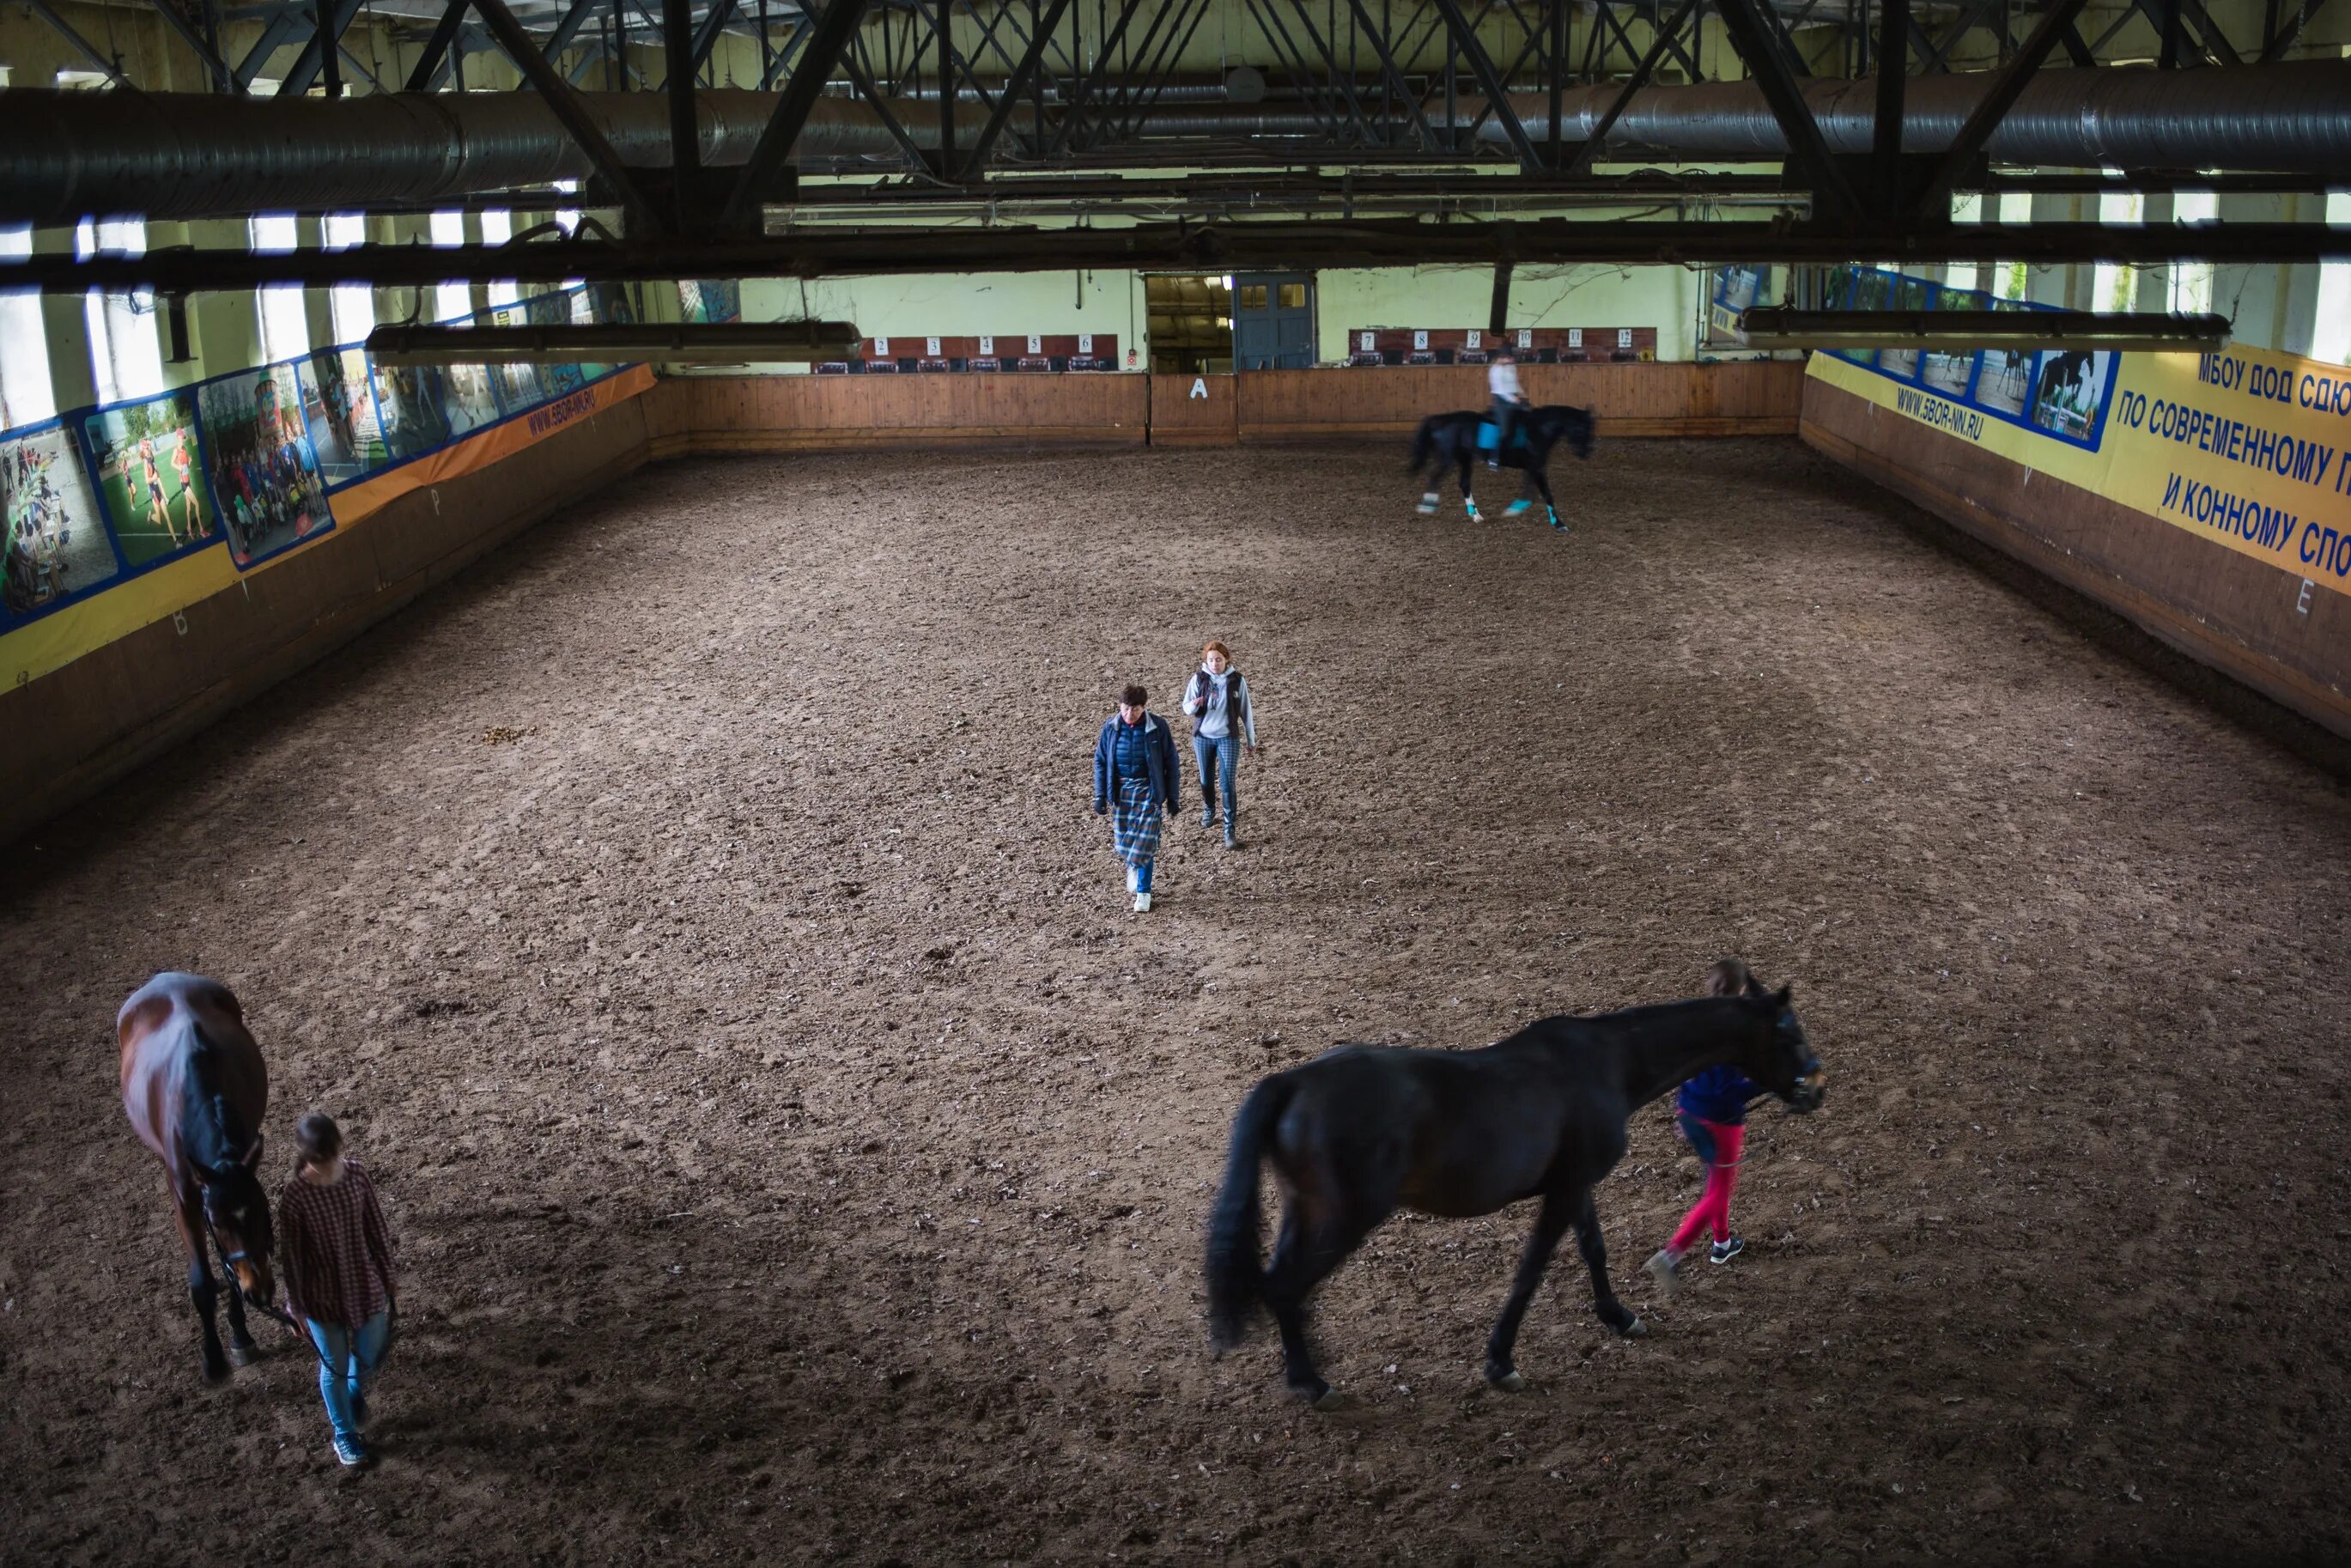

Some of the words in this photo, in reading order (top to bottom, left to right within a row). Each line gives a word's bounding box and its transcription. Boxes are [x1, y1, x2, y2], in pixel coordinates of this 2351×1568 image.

[1365, 336, 1371, 345] 7
[1418, 335, 1425, 344] 8
[1521, 332, 1530, 341] 10
[1571, 331, 1580, 340] 11
[878, 340, 884, 350] 2
[931, 342, 938, 350] 3
[983, 339, 989, 349] 4
[1031, 338, 1038, 349] 5
[1082, 338, 1089, 348] 6
[2198, 353, 2246, 391] МБОУ
[2249, 364, 2293, 404] ДОД
[1190, 378, 1208, 399] A
[2117, 390, 2147, 428] ПО
[2148, 399, 2334, 486] СОВРЕМЕННОМУ
[2162, 472, 2182, 510] И
[2181, 478, 2298, 552] КОННОМУ
[2299, 522, 2351, 577] СПО
[2296, 578, 2315, 614] E
